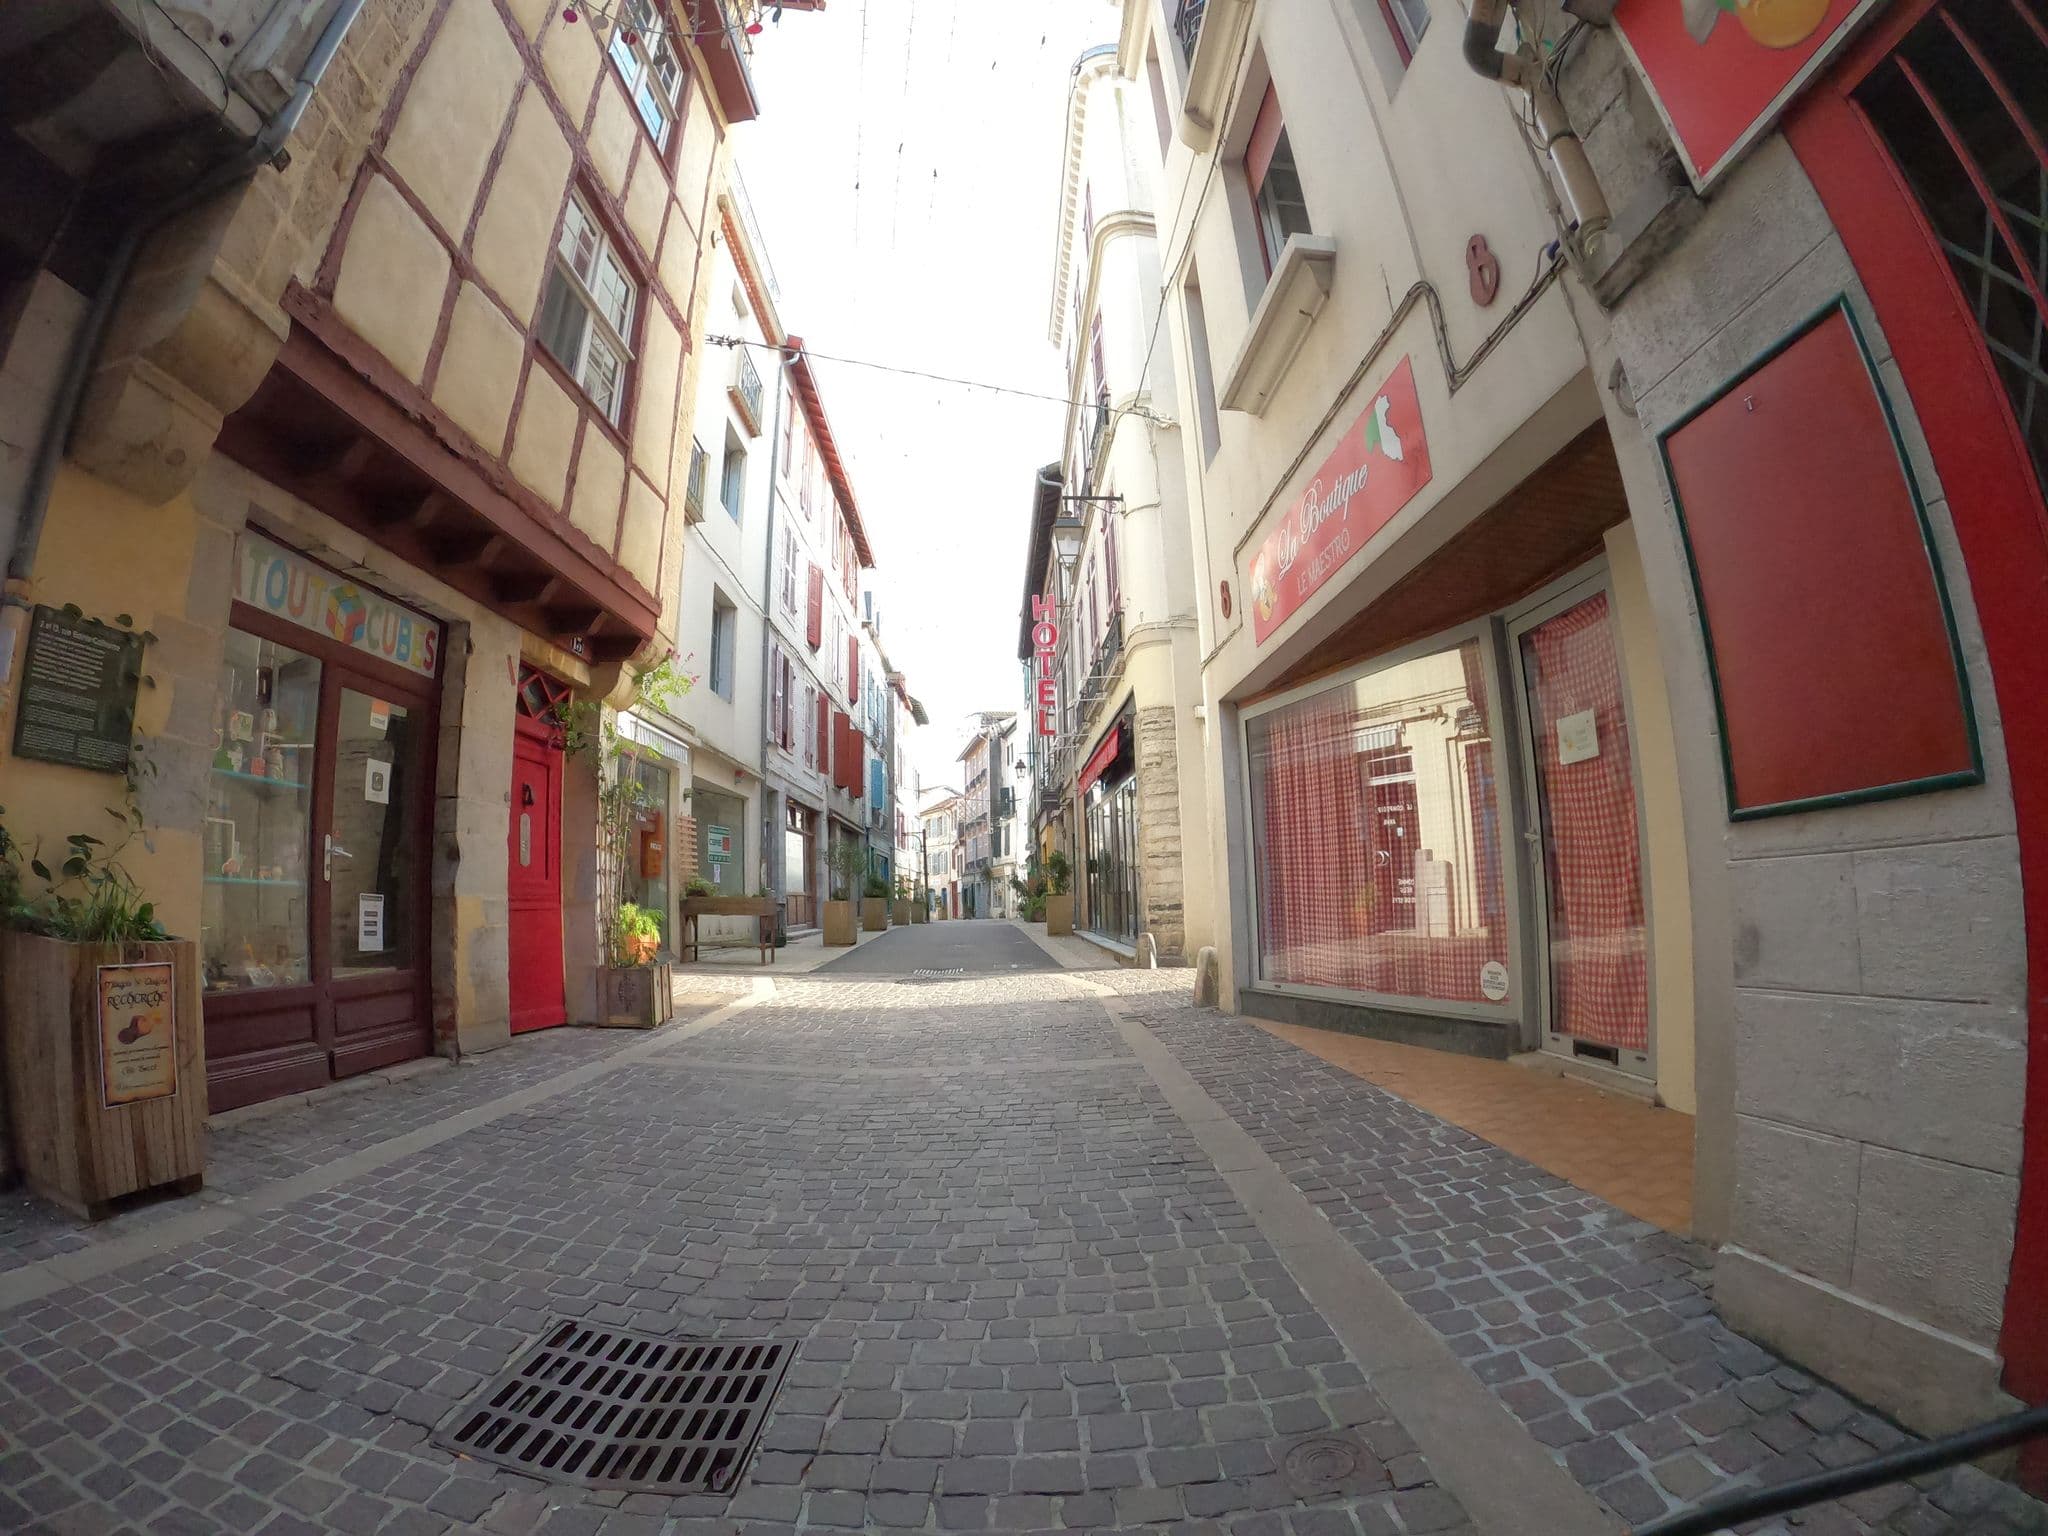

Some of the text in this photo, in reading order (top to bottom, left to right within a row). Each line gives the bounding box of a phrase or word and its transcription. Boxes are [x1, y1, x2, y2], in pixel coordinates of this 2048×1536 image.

[1277, 463, 1369, 580] La Boutique
[1296, 527, 1351, 597] LE MAESTRO
[365, 602, 438, 671] CUBES
[1031, 594, 1058, 737] HOTEL
